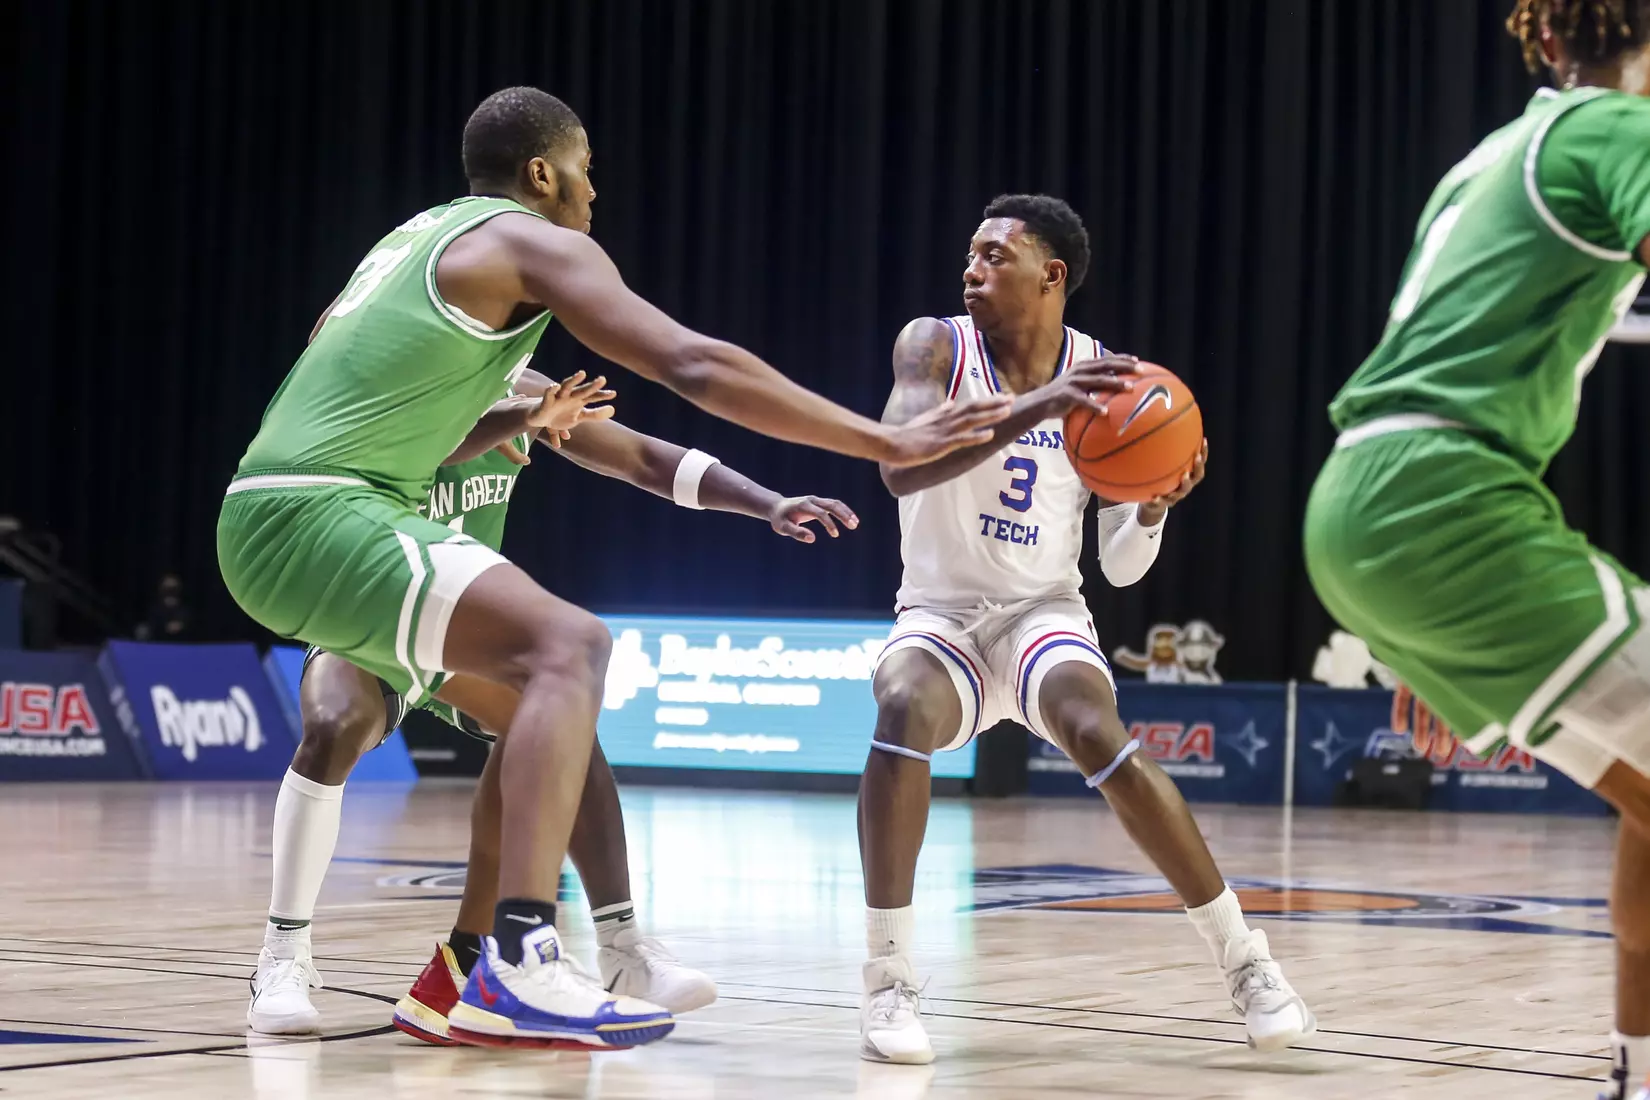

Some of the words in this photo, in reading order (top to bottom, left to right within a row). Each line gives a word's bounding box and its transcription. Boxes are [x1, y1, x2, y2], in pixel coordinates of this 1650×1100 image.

[461, 474, 516, 512] GREEN
[999, 455, 1038, 513] 3
[979, 513, 1039, 546] TECH
[1129, 721, 1215, 762] SA
